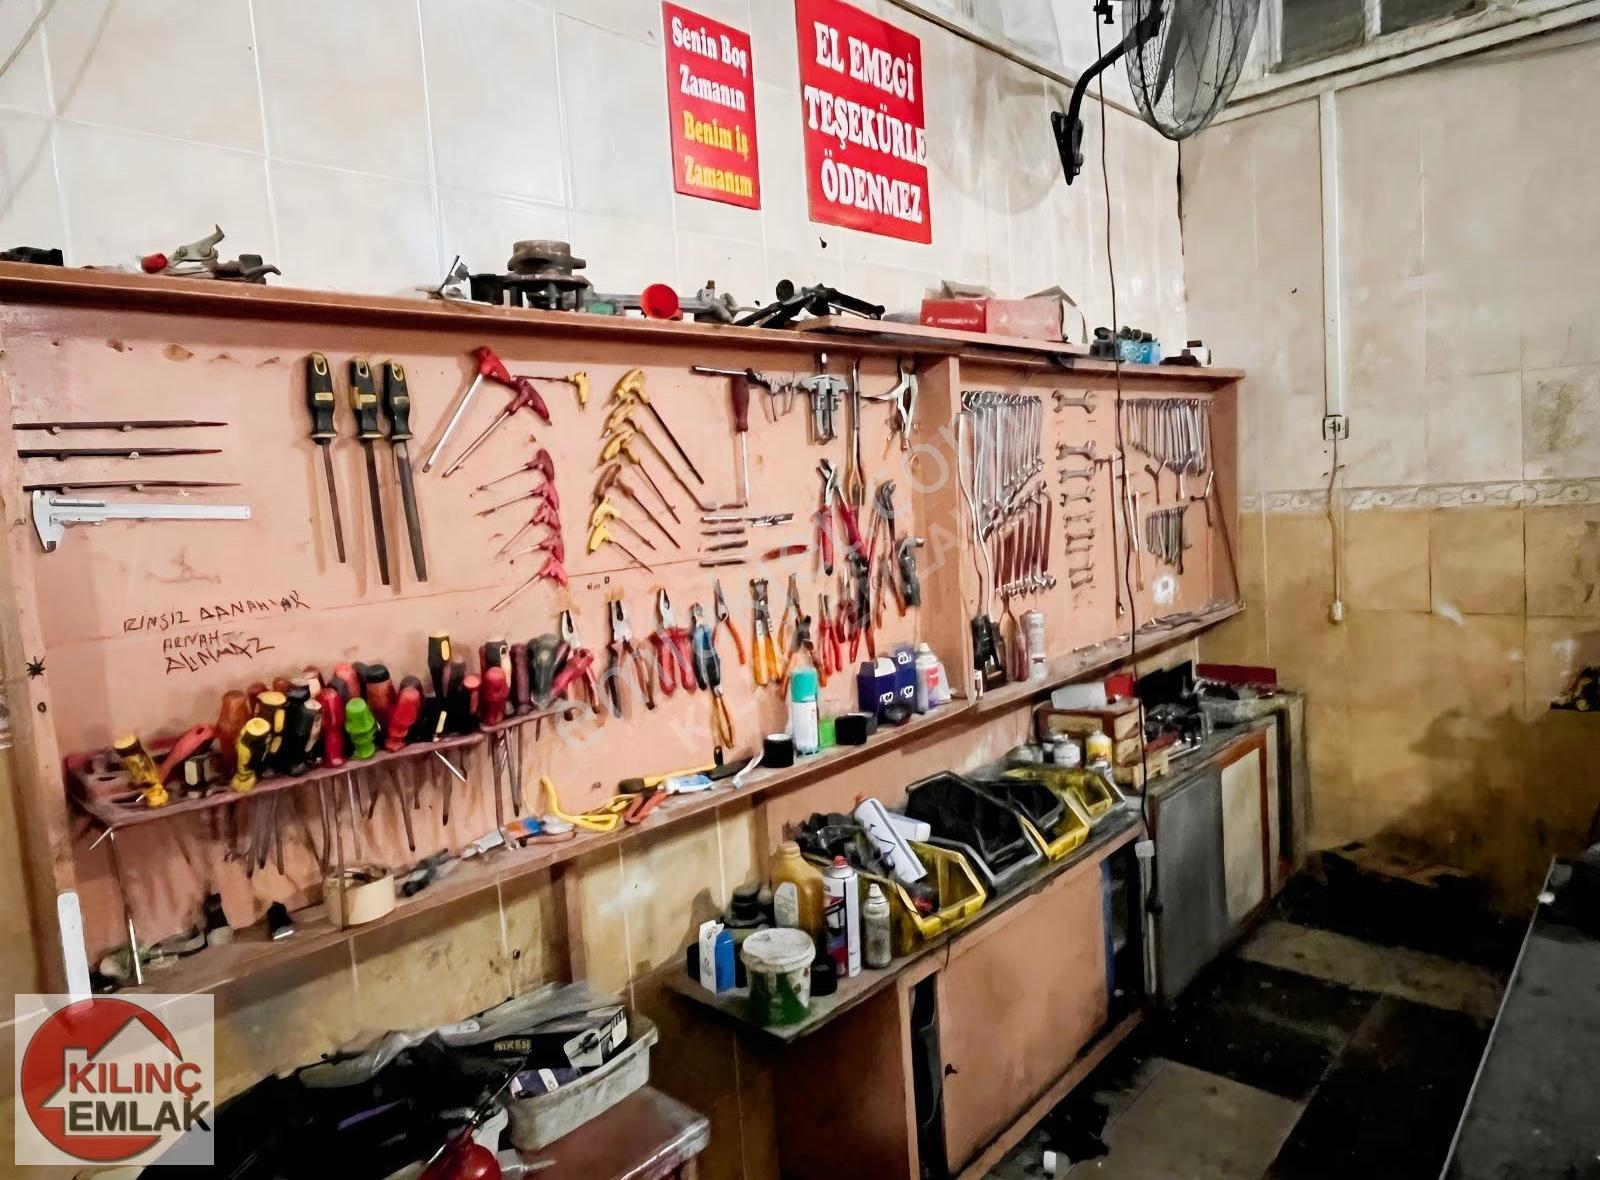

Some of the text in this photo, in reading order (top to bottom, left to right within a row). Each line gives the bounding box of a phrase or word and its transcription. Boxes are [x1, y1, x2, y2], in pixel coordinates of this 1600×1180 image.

[671, 16, 747, 78] Senin Boş
[813, 21, 845, 75] EL
[679, 64, 746, 112] Zamanın
[683, 111, 733, 150] Benim
[804, 84, 926, 167] TEŞEKÜRLE
[684, 155, 753, 198] Zamanım
[821, 148, 923, 224] ÖDENMEZ
